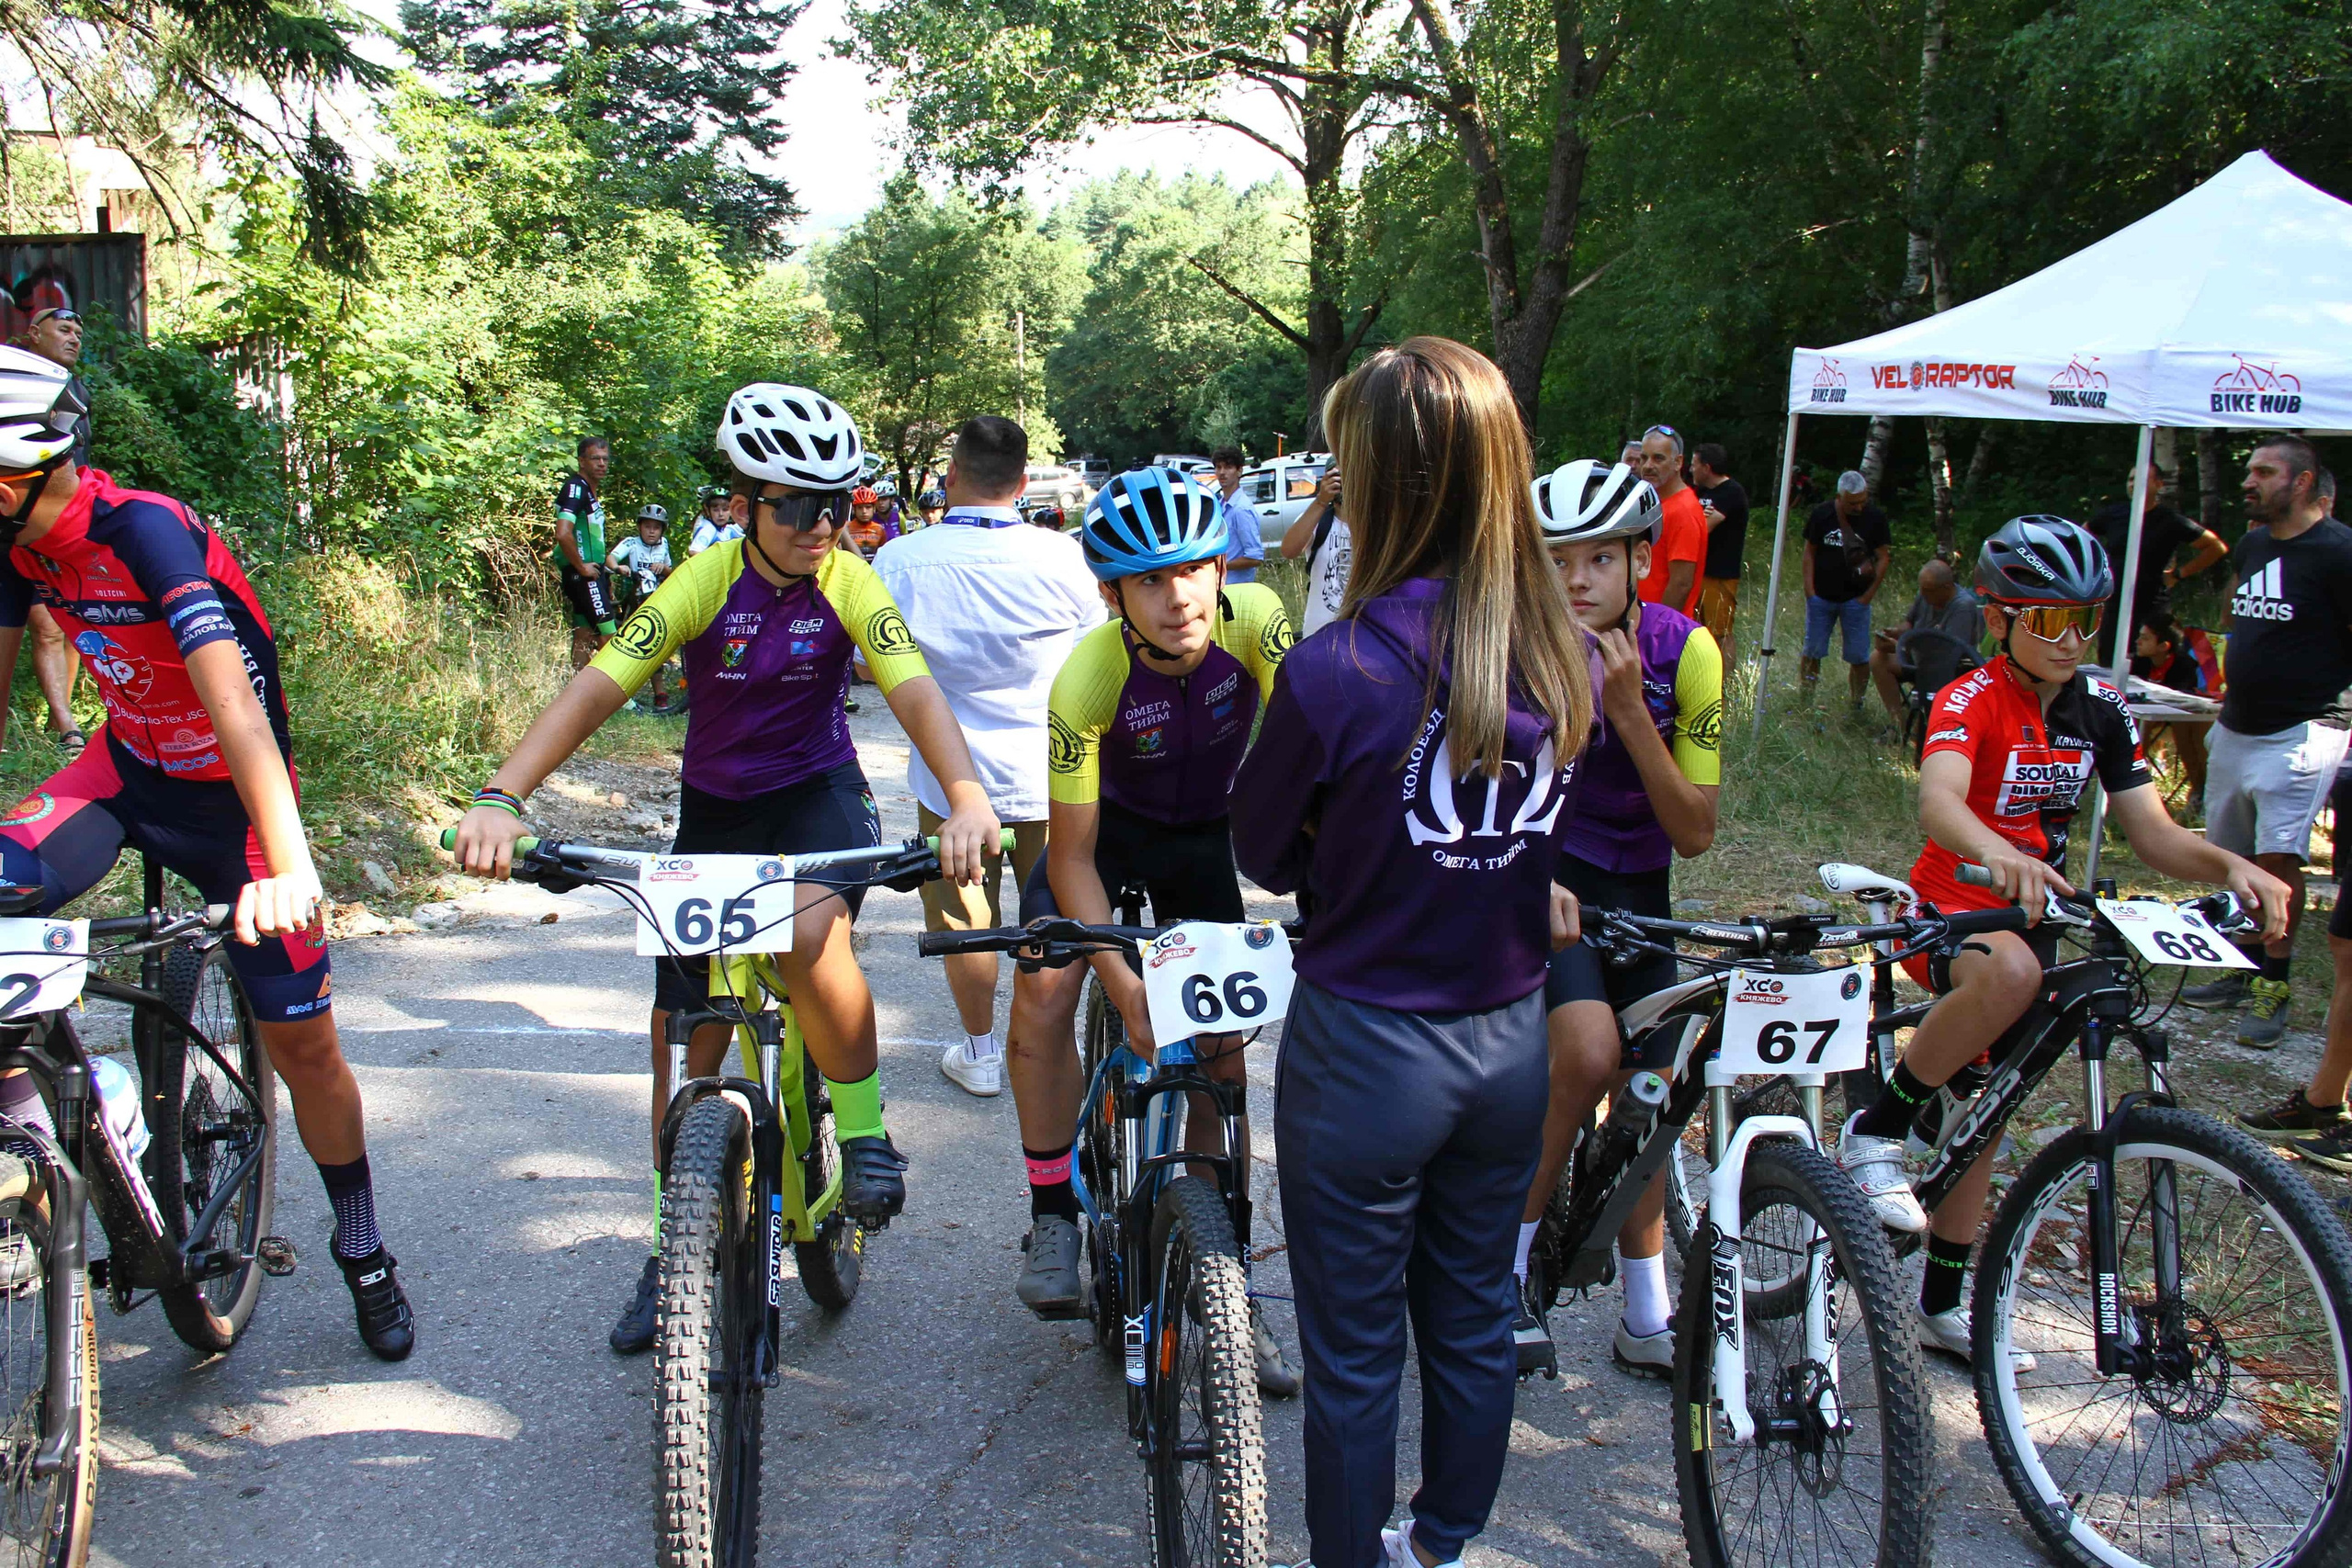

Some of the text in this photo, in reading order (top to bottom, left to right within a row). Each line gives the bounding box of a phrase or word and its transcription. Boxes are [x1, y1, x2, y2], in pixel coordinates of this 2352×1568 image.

[1811, 389, 1847, 402] BIKE HUB
[2048, 390, 2107, 408] BIKE HUB
[2211, 394, 2301, 413] BIKE HUB
[2016, 547, 2055, 581] BJÖRKA
[587, 581, 605, 616] BEROE
[2231, 593, 2294, 621] adidas
[800, 672, 820, 682] Spt
[121, 707, 208, 725] Bulgaria-Tex JSC
[1125, 700, 1171, 721] ОМЕГА
[1128, 710, 1171, 731] ТИЙМ
[2010, 784, 2051, 795] bike
[1432, 838, 1528, 871] ОМЕГА ТИЙМ
[674, 897, 757, 945] 65
[1706, 929, 1751, 942] RENTHAL
[2153, 931, 2222, 962] 68
[1182, 971, 1268, 1024] 66
[1739, 994, 1782, 1003] КНЯЖЕВО
[1757, 1019, 1840, 1064] 67
[359, 1267, 387, 1286] SIDI
[1713, 1263, 1738, 1350] FOX
[2098, 1272, 2119, 1335] ROCKSHOX
[86, 1389, 100, 1506] BARZO
